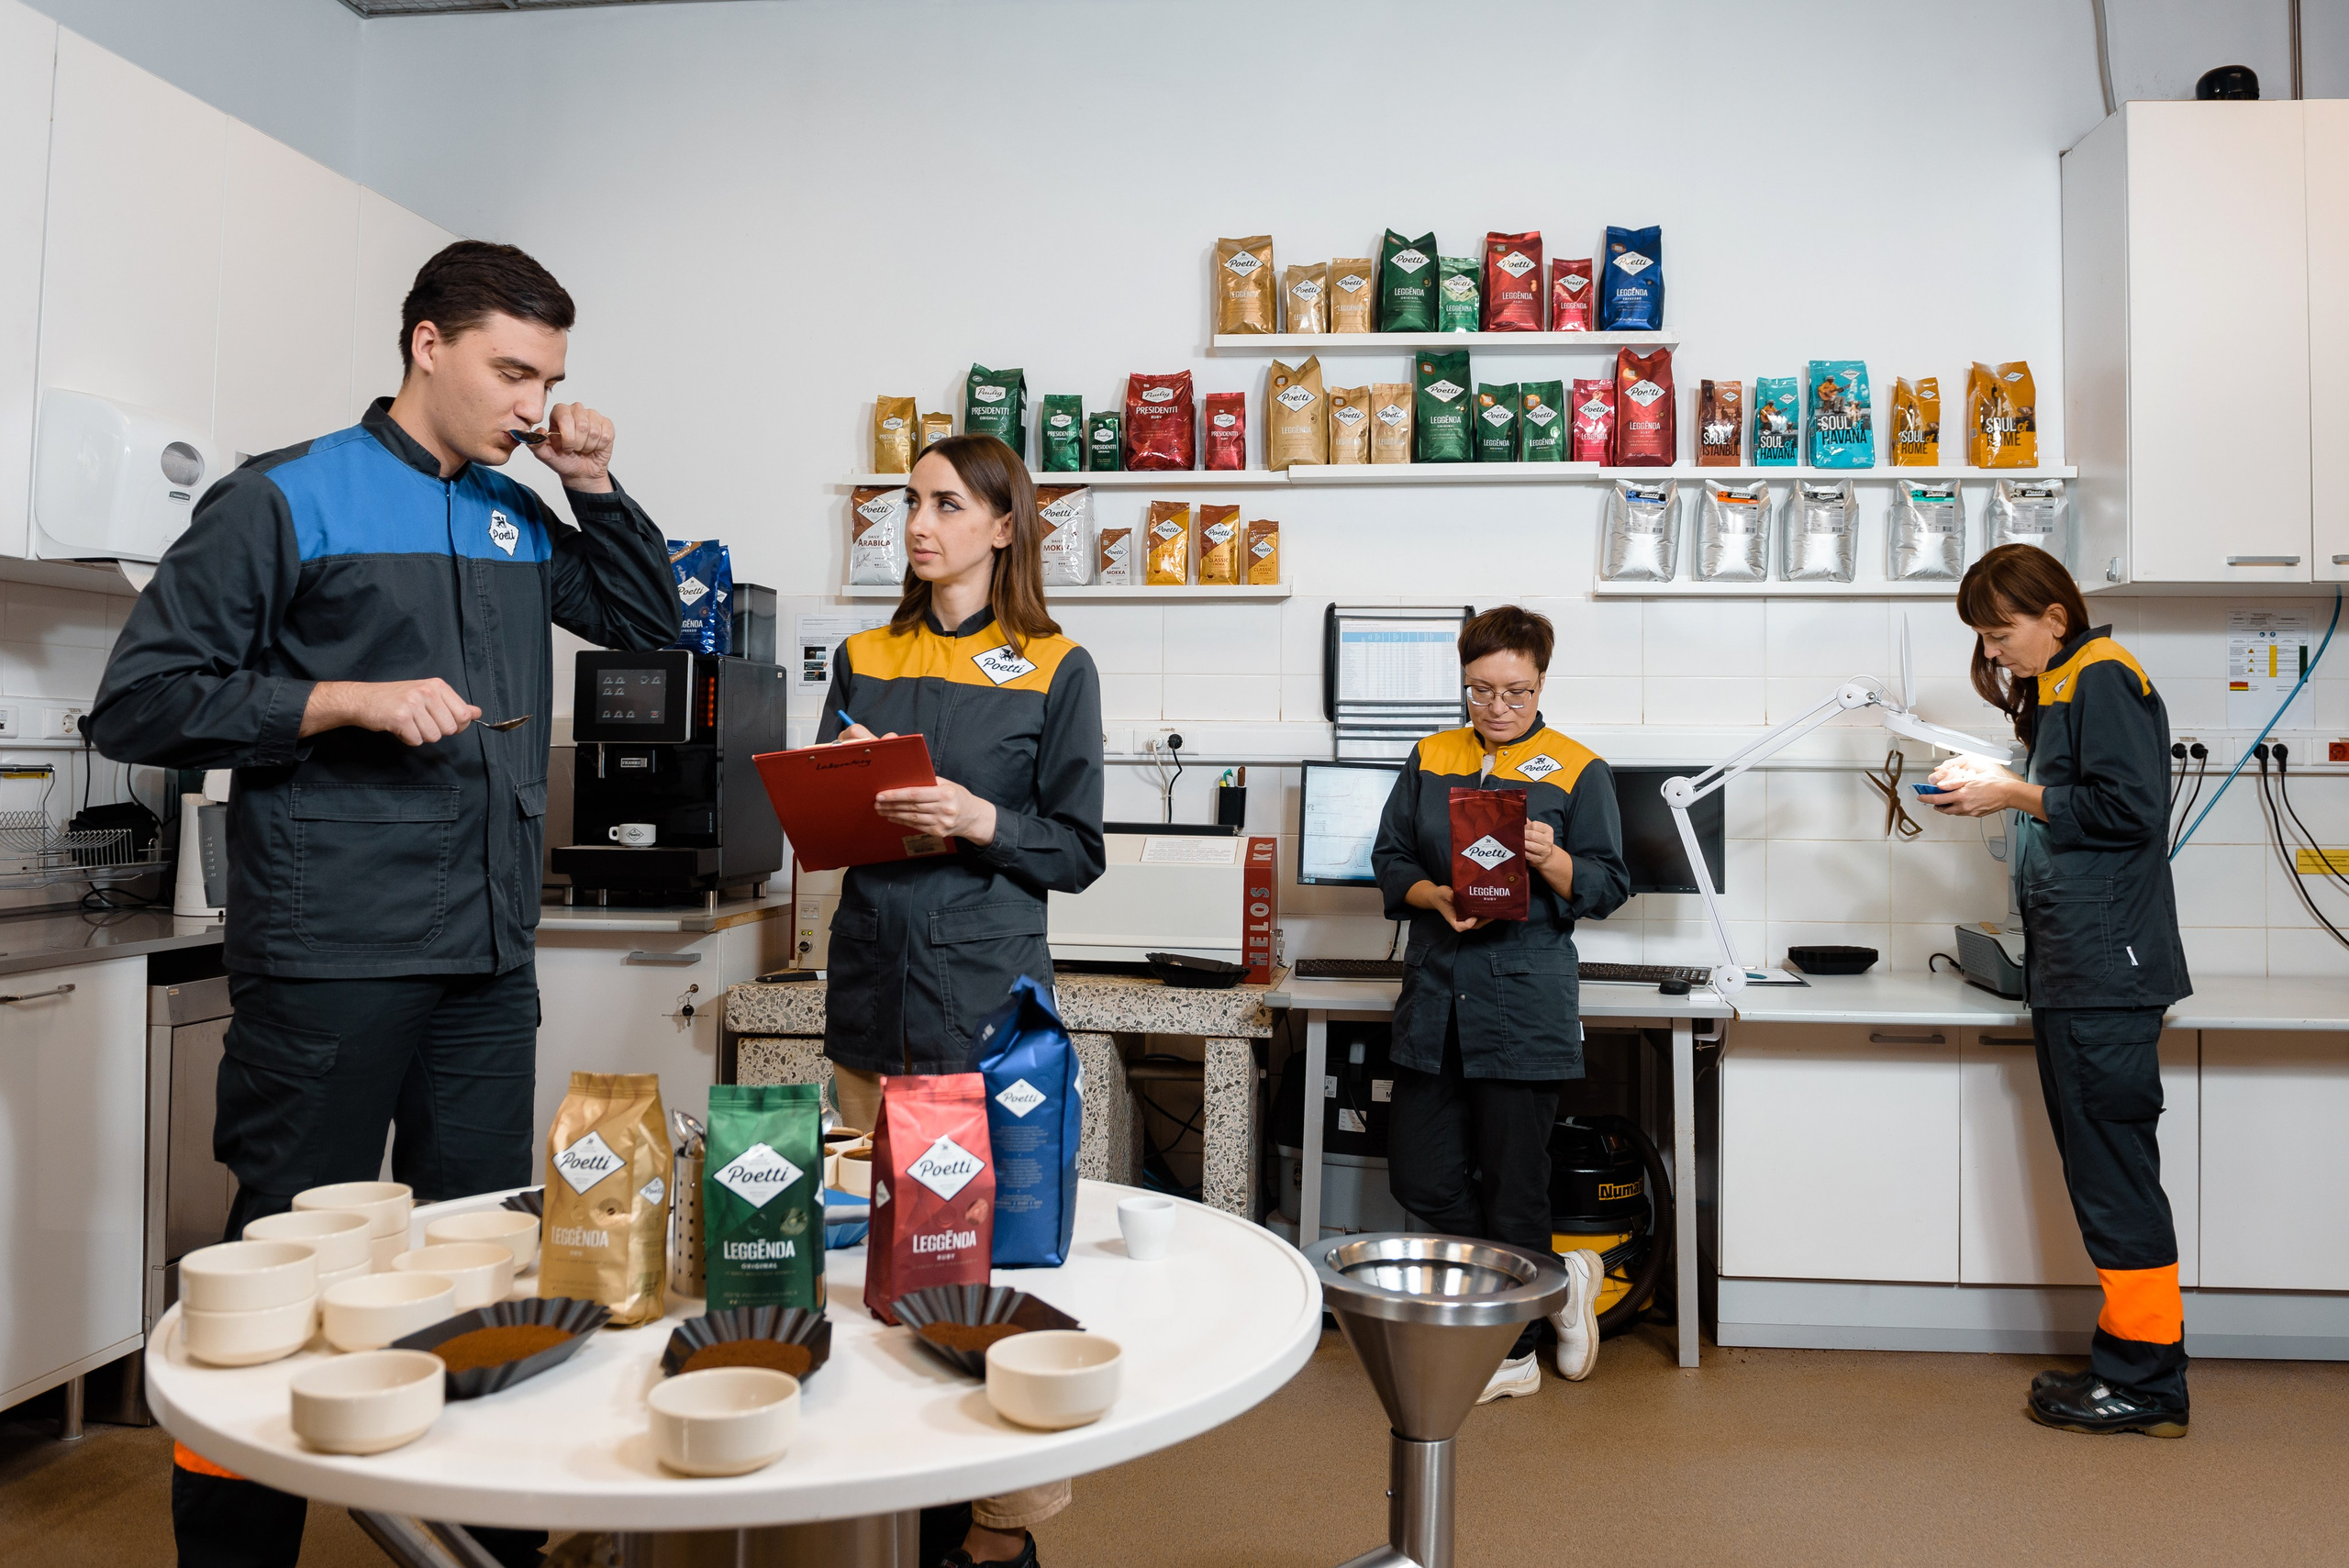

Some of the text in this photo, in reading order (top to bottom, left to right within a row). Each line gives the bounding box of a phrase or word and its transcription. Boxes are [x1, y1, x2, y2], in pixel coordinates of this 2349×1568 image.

[1230, 259, 1258, 268] Poetti
[1396, 255, 1425, 264] Poetti
[1502, 259, 1531, 269] Poetti
[1563, 278, 1585, 286] Poetti
[1295, 285, 1318, 294] Poetti
[977, 388, 1004, 397] Paulig
[1431, 386, 1459, 395] Poetti
[1631, 388, 1660, 396] Poetti
[1281, 394, 1309, 402] Poetti
[971, 406, 1009, 416] PRESIDENTTI
[1136, 406, 1178, 415] PRESIDENTTI
[1486, 411, 1509, 419] Poetti
[1531, 411, 1553, 419] Poetti
[1820, 416, 1851, 430] SOUL
[2017, 420, 2028, 432] of
[1822, 429, 1867, 444] HAVANA
[1901, 430, 1935, 443] SOUL of
[1760, 436, 1794, 448] SOUL of
[1702, 444, 1740, 456] ISTANBUL
[1901, 442, 1928, 454] ROME
[1761, 448, 1795, 460] HAVANA
[862, 505, 889, 514] Poetti
[1043, 508, 1072, 517] Poetti
[1208, 528, 1230, 537] Poetti
[983, 657, 1026, 673] Poetti
[816, 758, 872, 771] Laboratory
[1523, 763, 1553, 773] Poetti
[1468, 846, 1508, 859] Poetti
[1249, 842, 1274, 966] HELOS KR
[1003, 1092, 1038, 1104] Poetti
[560, 1151, 611, 1171] Poetti
[918, 1159, 973, 1177] Poetti
[728, 1165, 789, 1184] Poetti
[740, 1262, 778, 1270] ORIGINAL
